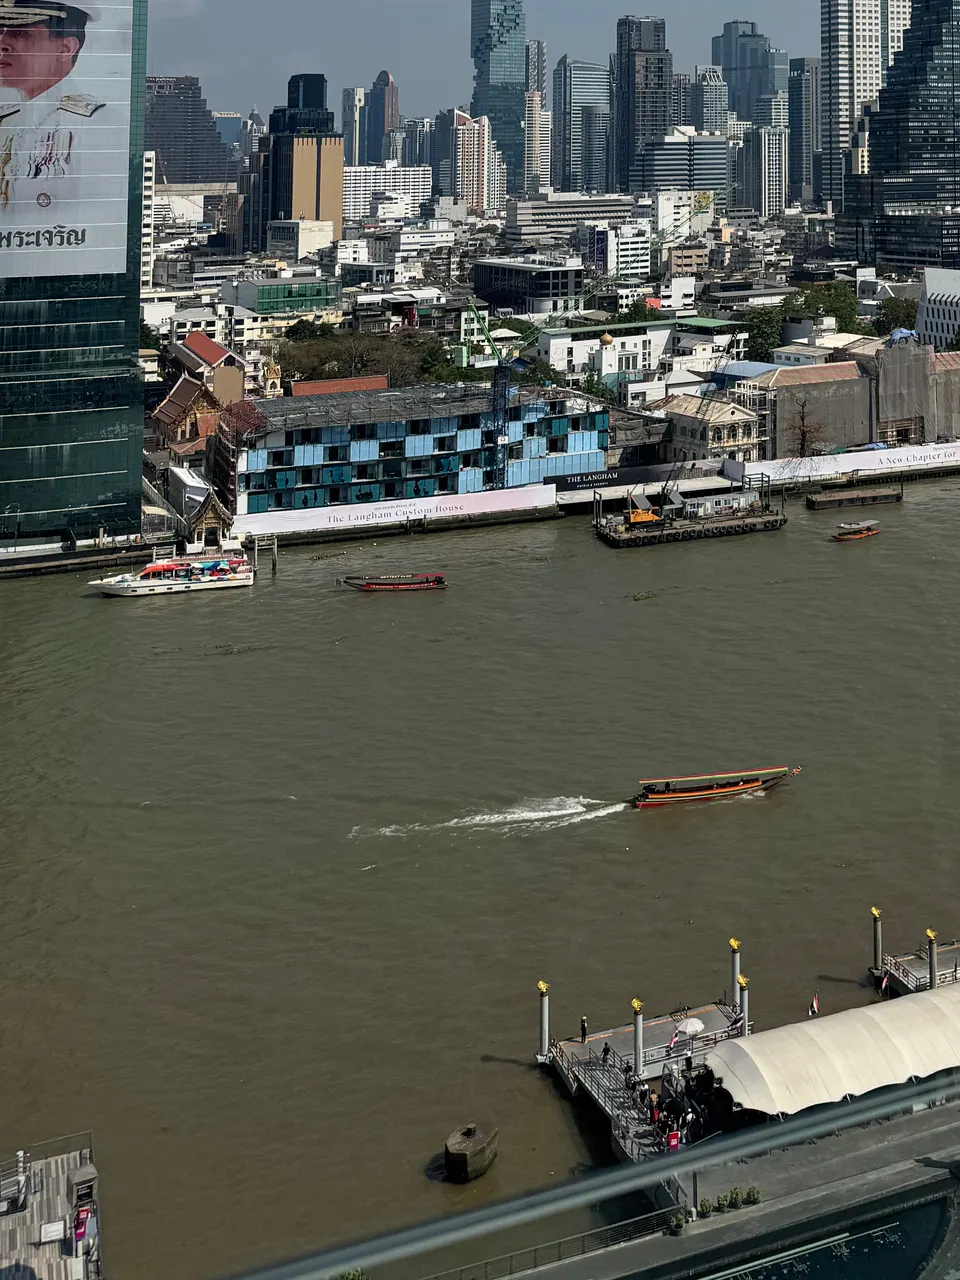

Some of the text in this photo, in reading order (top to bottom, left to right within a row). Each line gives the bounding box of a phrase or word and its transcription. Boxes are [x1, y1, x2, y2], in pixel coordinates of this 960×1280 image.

[906, 453, 941, 463] Chapter
[944, 450, 956, 458] for
[583, 472, 618, 482] LANGHAM
[326, 504, 465, 524] The Langham Custom House
